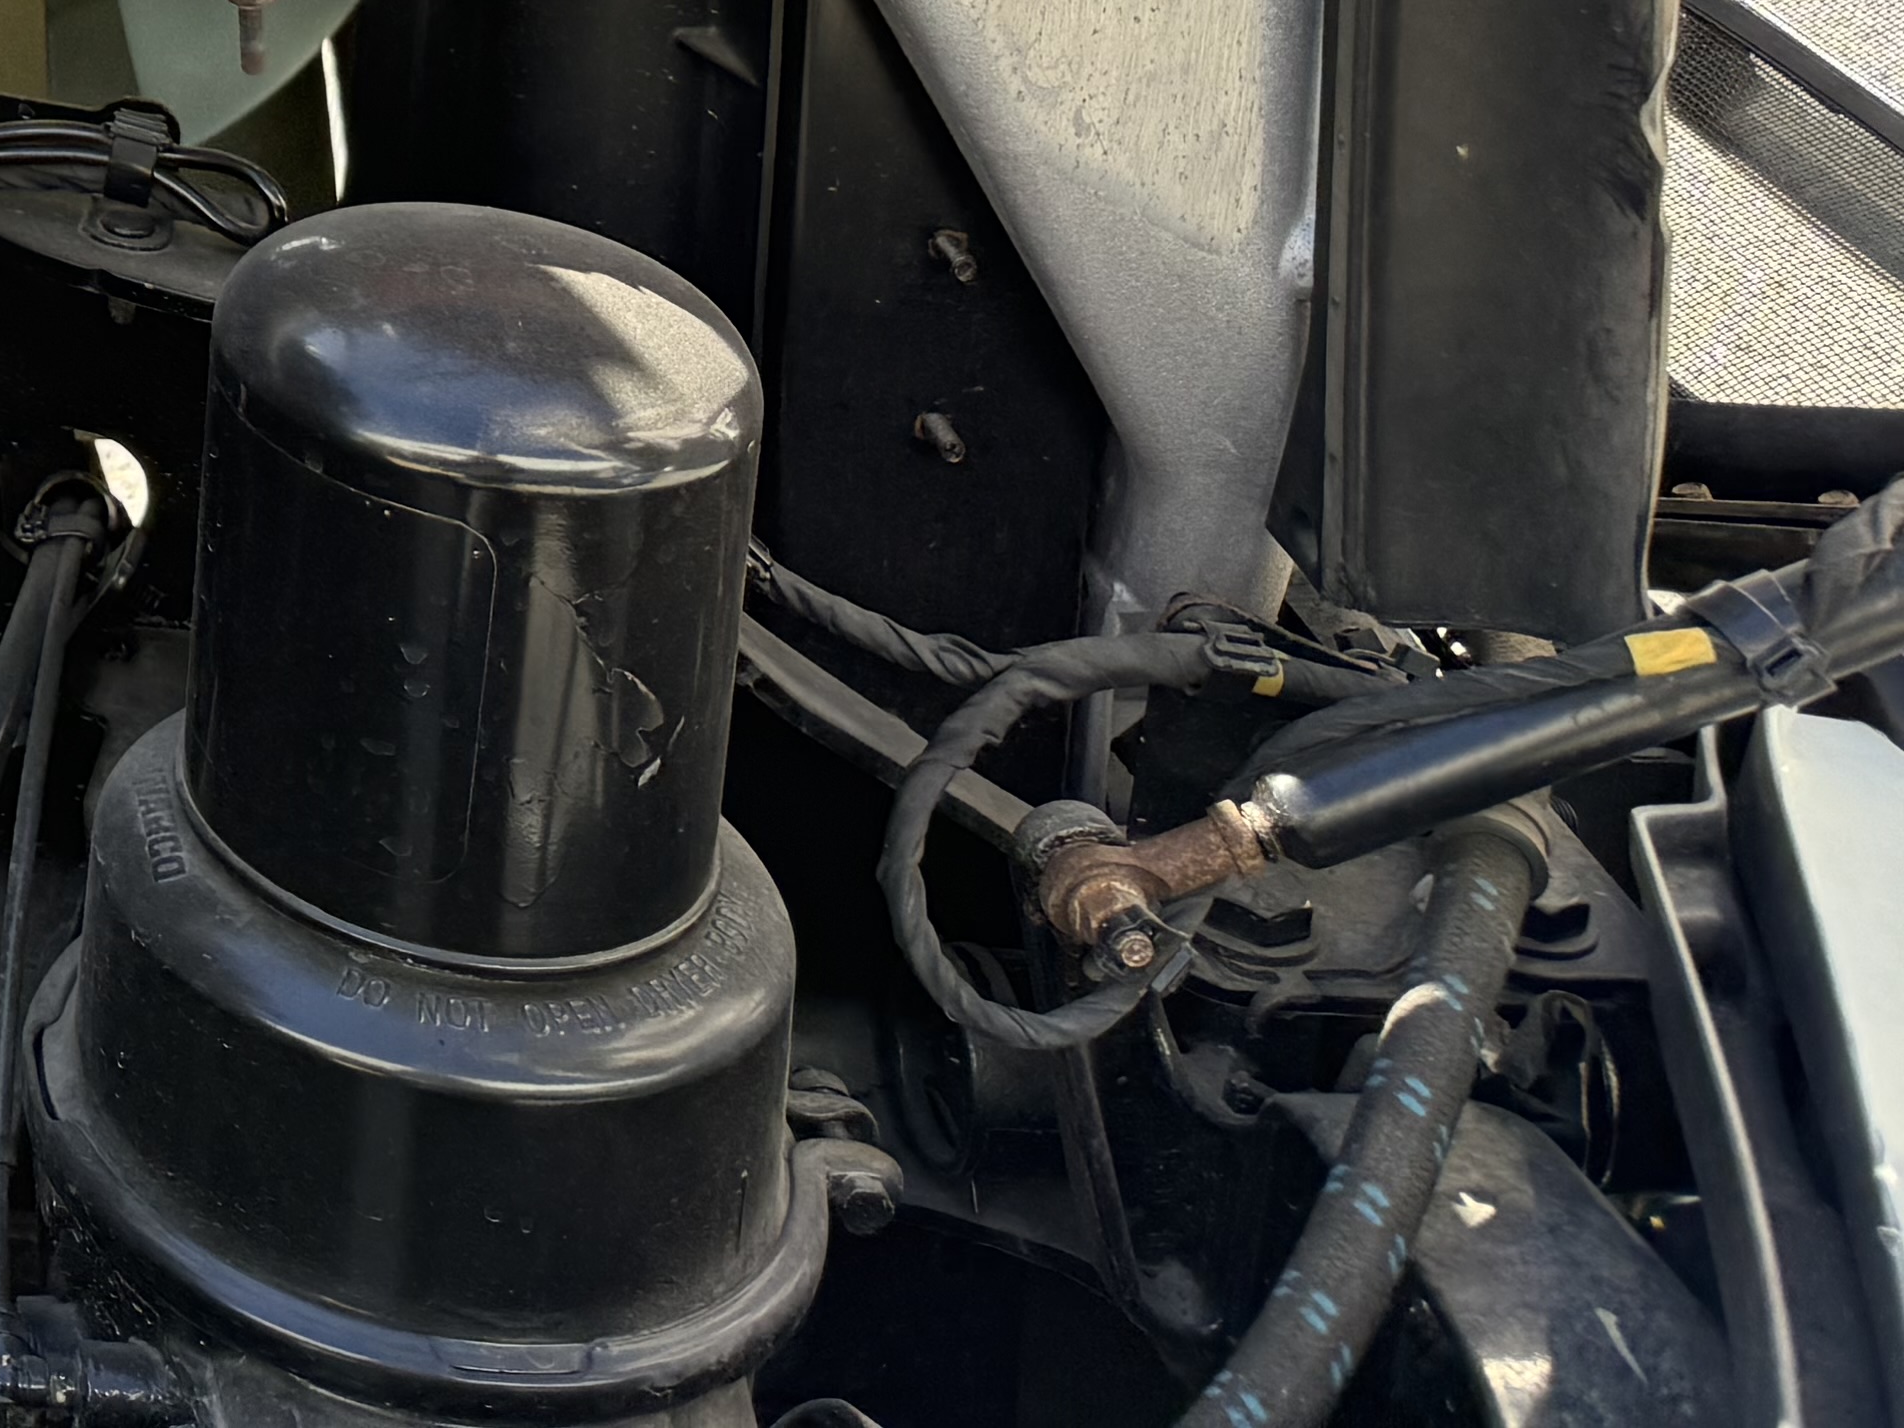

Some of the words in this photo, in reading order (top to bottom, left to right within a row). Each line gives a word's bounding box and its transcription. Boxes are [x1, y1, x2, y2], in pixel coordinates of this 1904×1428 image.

[335, 966, 393, 1010] DO
[416, 991, 491, 1035] NOT
[519, 992, 612, 1038] OPEN
